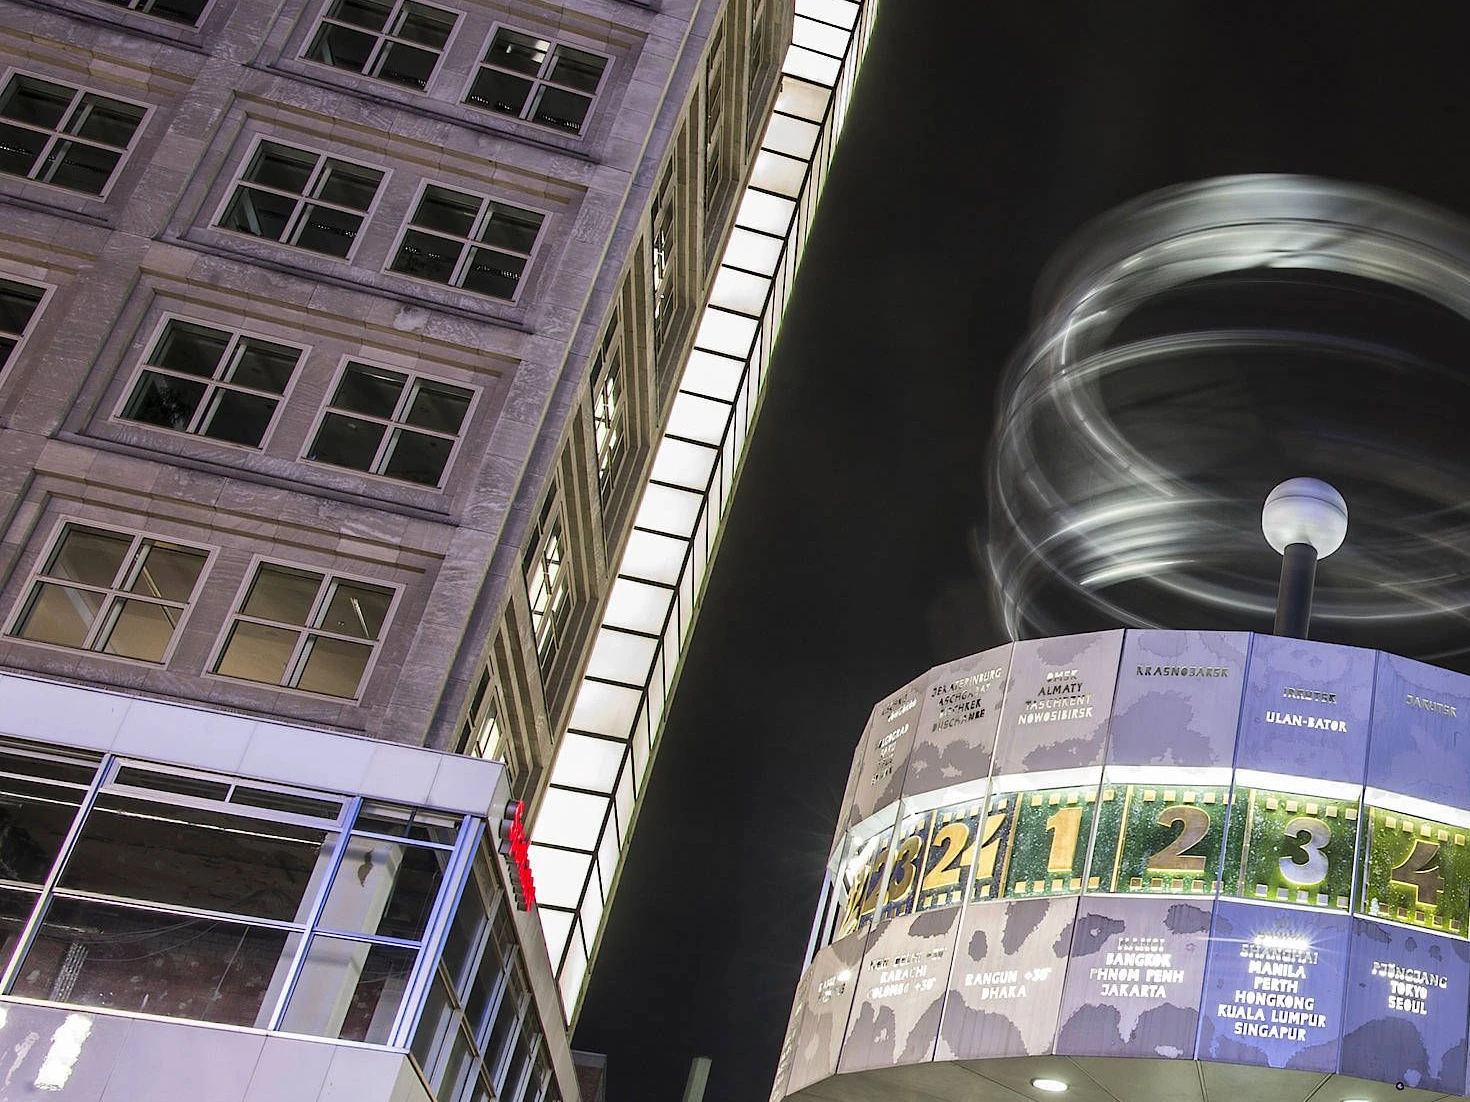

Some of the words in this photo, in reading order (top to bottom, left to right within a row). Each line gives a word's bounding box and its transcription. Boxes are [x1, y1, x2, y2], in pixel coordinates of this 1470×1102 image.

[1038, 683, 1083, 697] ALMATY
[1018, 707, 1093, 725] NOWOSIBIRSK
[1266, 711, 1347, 732] ULAN-BATOR
[1045, 807, 1082, 872] 1
[1147, 805, 1210, 872] 2
[922, 813, 1007, 890] 24
[1279, 817, 1331, 885] 3
[1391, 839, 1443, 907] 4
[1105, 952, 1171, 968] BANGKOK
[1239, 943, 1318, 964] SHANGHAI
[880, 965, 927, 983] KARACHI
[965, 970, 1018, 986] RANGUN
[1090, 967, 1140, 982] PHNOM
[1146, 969, 1184, 983] PENH
[1248, 960, 1306, 979] MANILA
[981, 984, 1027, 1000] DHAKA
[1100, 983, 1166, 998] JAKARTA
[1253, 976, 1298, 993] PERTH
[1390, 979, 1428, 999] TOKYO
[1234, 990, 1315, 1010] HONGKONG
[1388, 995, 1427, 1015] SEOUL
[1217, 1004, 1265, 1022] KUALA
[1271, 1009, 1327, 1028] LUMPUR
[1234, 1021, 1307, 1042] SINGAPUR
